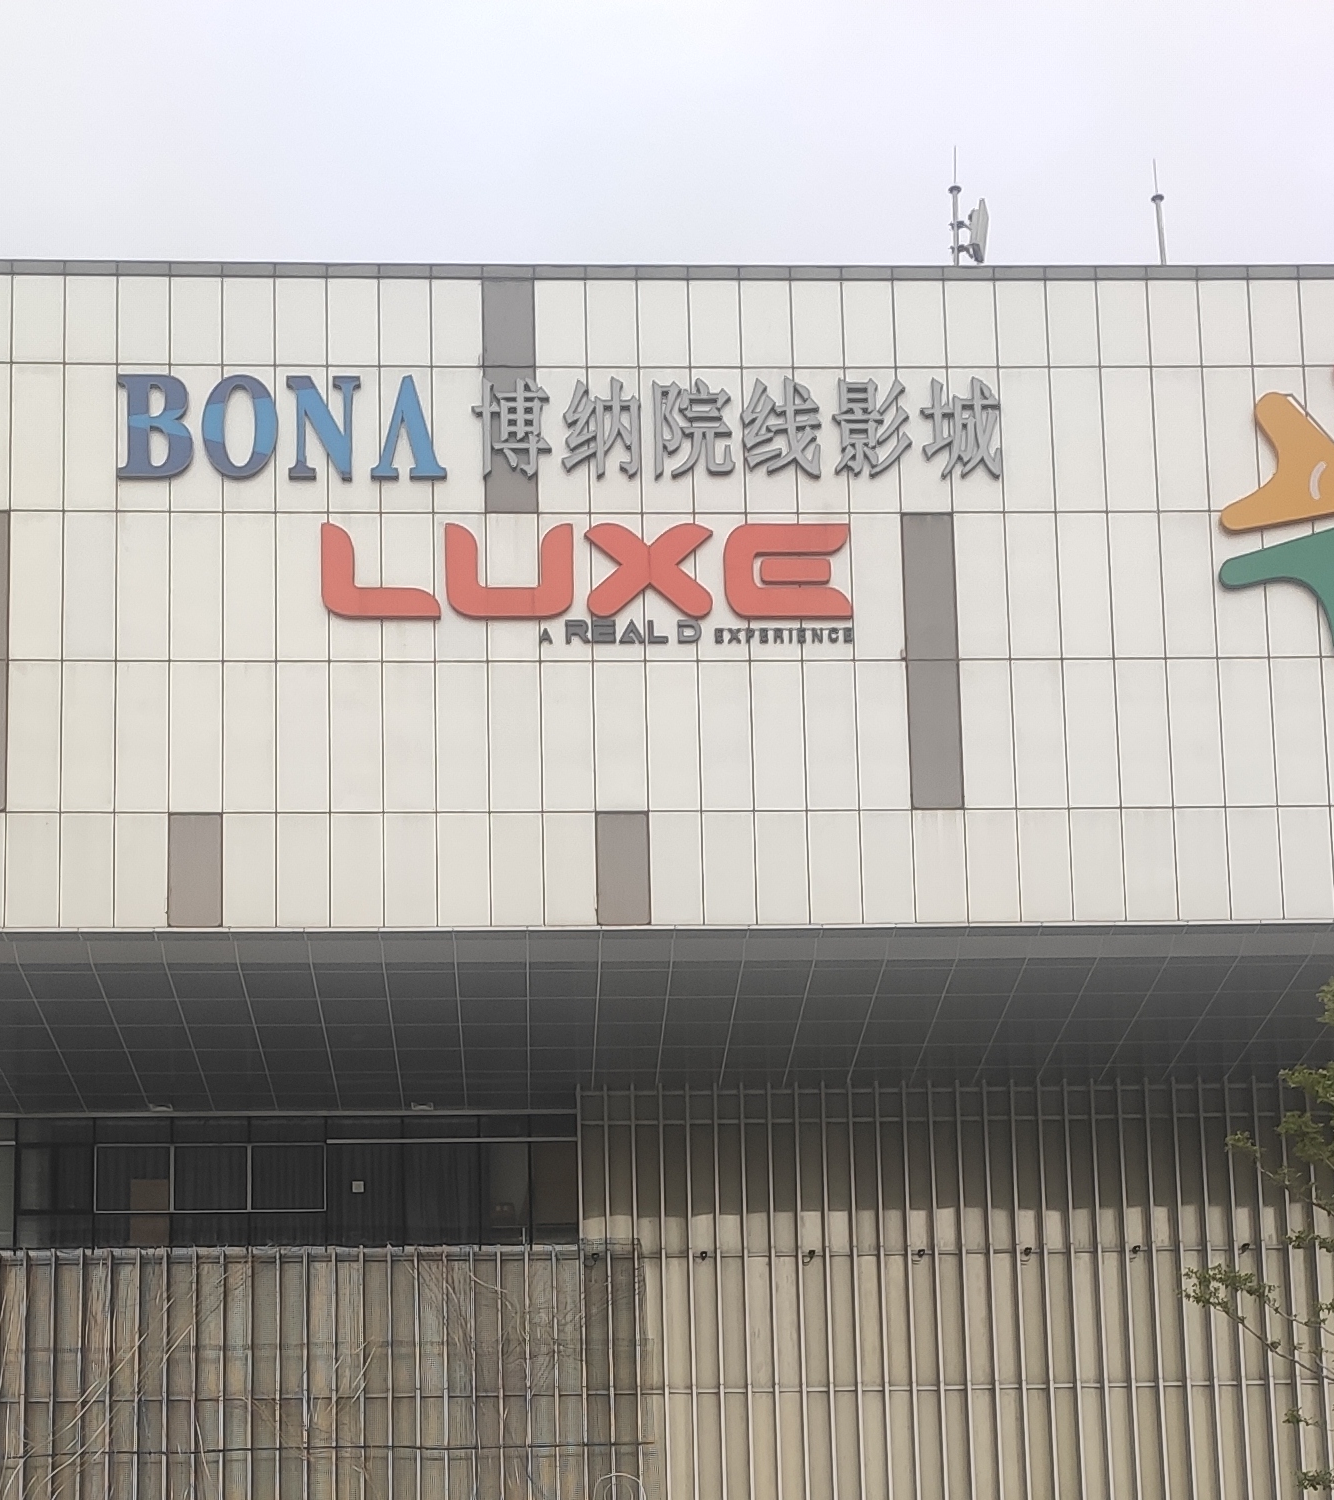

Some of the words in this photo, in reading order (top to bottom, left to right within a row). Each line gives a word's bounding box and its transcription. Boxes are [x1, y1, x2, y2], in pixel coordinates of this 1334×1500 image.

[116, 373, 448, 482] BONA
[473, 376, 1004, 483] 博纳院线影城
[321, 521, 853, 620] LUXE
[713, 627, 854, 645] EXPERIENCE
